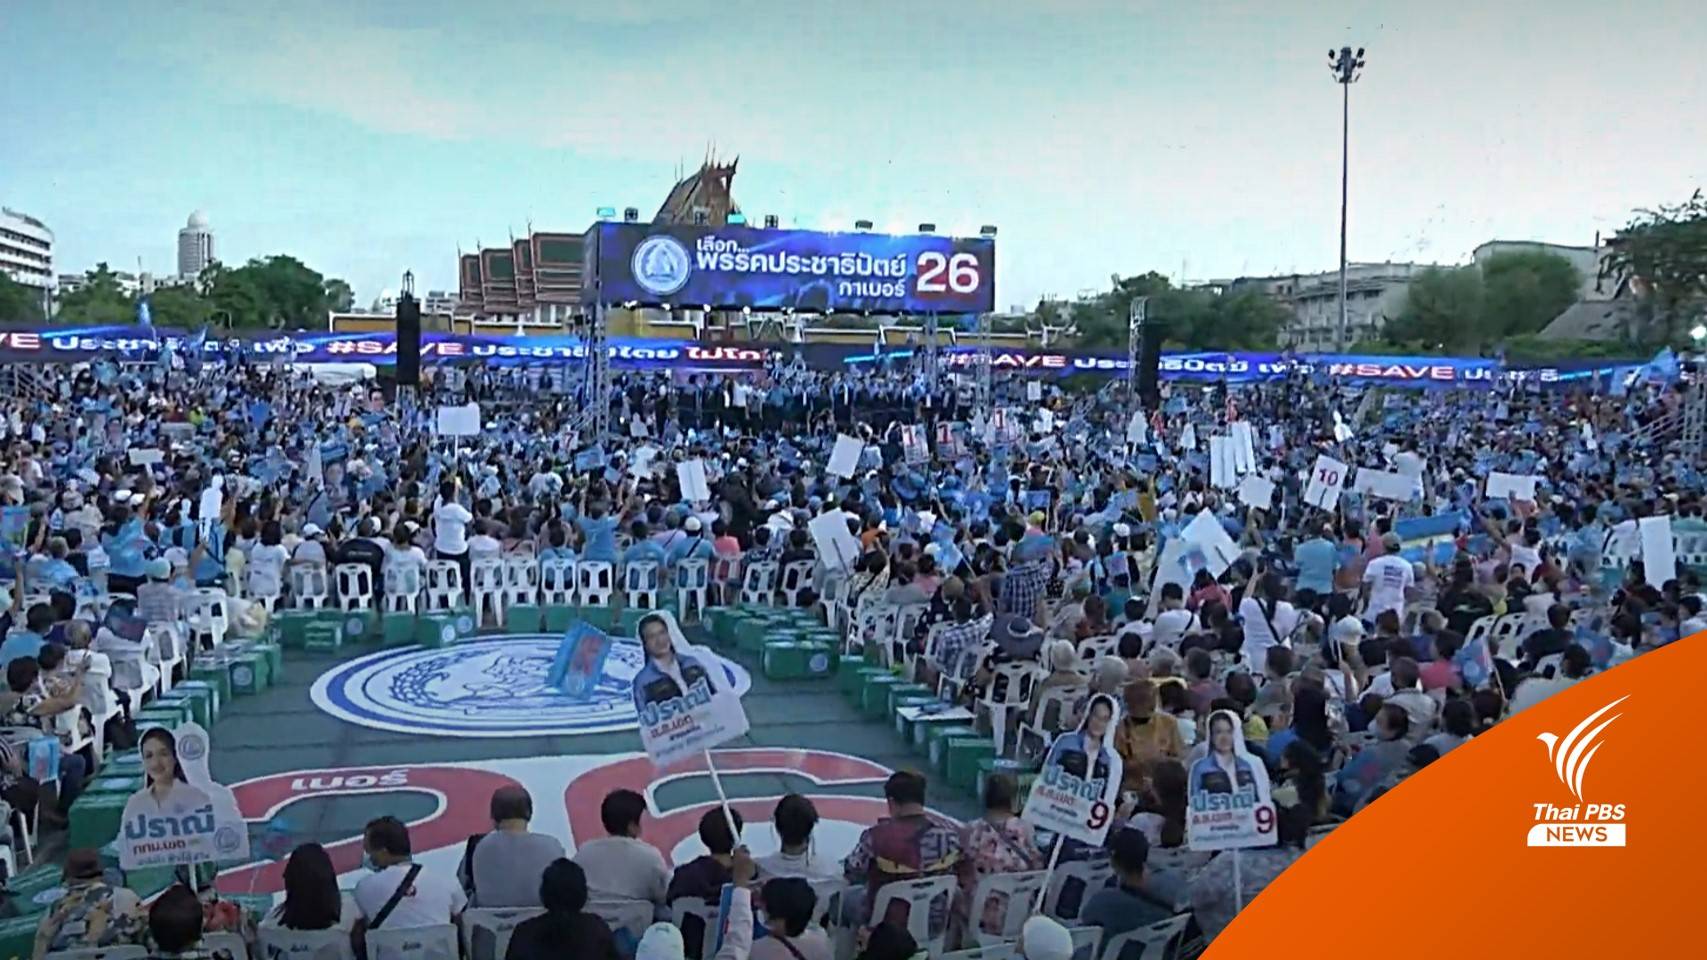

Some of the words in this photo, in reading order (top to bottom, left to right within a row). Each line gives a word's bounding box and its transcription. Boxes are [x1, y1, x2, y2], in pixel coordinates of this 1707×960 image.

[696, 250, 907, 277] พรรคประชาธิปัตย์
[916, 251, 980, 294] 26
[839, 279, 906, 297] กาเบอร์
[1330, 363, 1454, 380] #SAVE
[1319, 467, 1339, 487] 10
[641, 675, 711, 727] ปราณี
[291, 769, 409, 791] เบอร์
[1043, 764, 1105, 802] ปราณี
[1191, 783, 1254, 812] ปราณี
[124, 804, 216, 840] ปราณี
[1086, 801, 1109, 830] 9
[1255, 804, 1276, 834] 9
